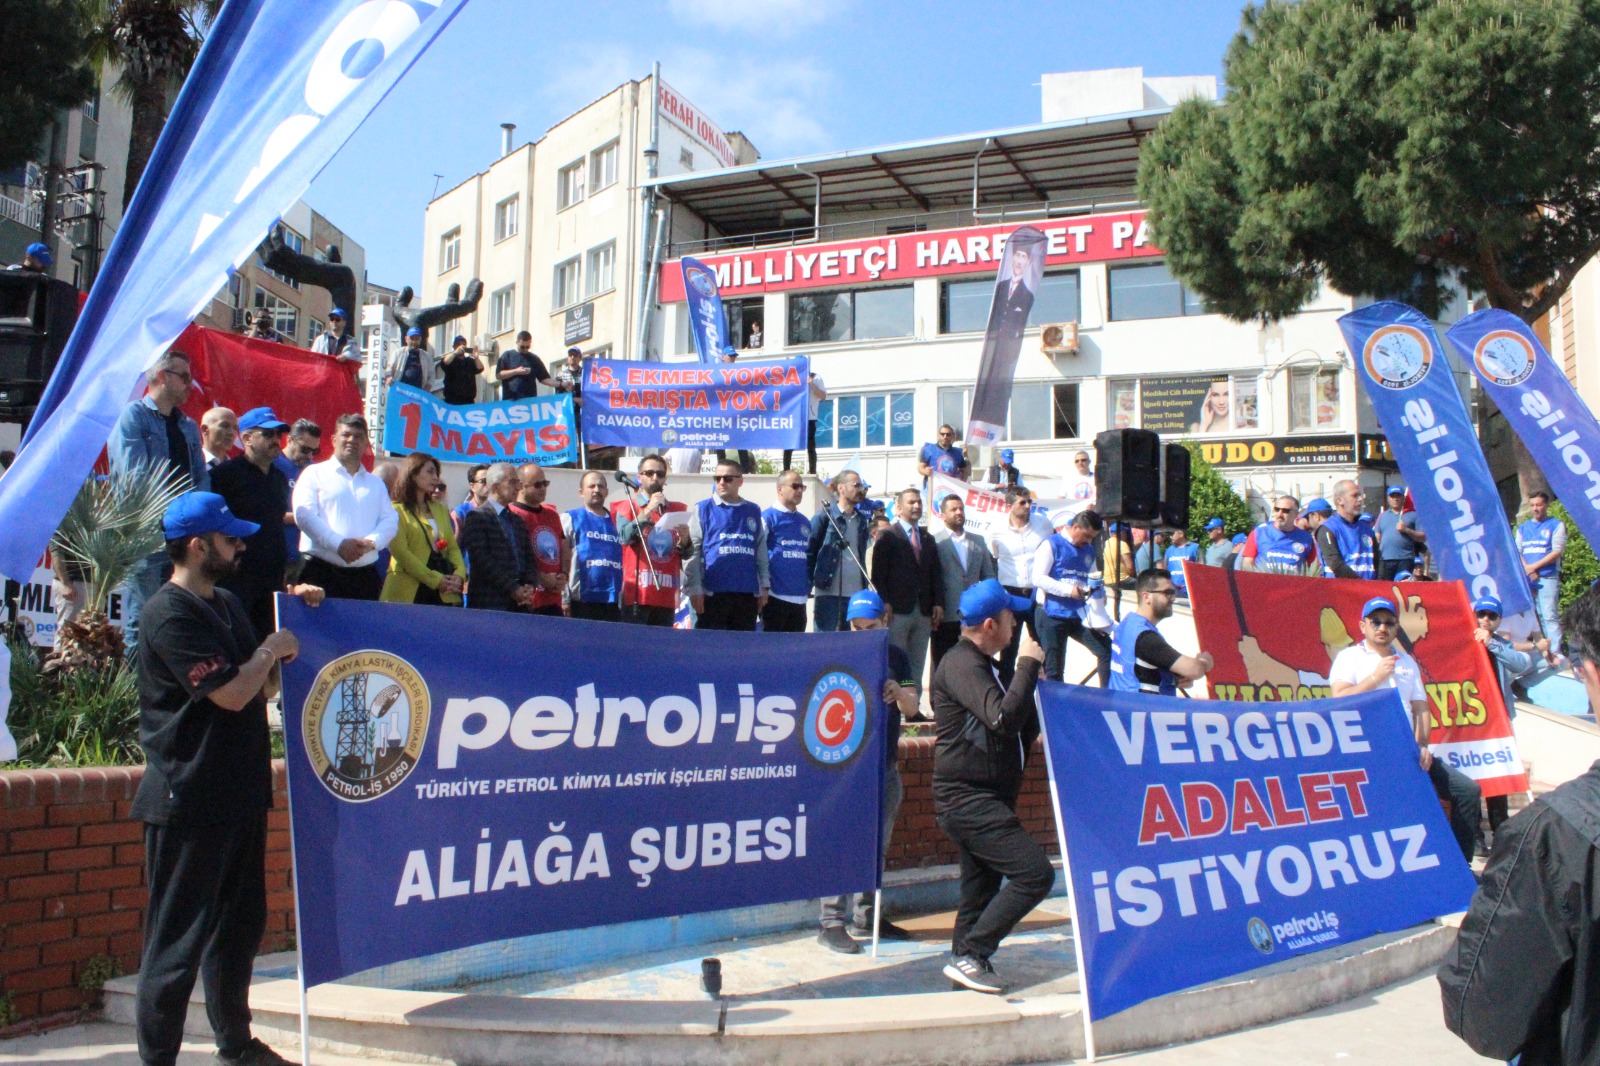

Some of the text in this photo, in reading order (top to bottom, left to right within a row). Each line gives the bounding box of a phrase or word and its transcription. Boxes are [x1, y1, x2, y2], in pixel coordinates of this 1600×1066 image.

[659, 86, 694, 130] FERAH
[707, 240, 897, 288] MİLLİYETÇİ
[916, 225, 1092, 268] HAREET
[627, 368, 715, 386] EKMEK
[718, 366, 801, 386] YOKSA
[432, 402, 563, 431] YAŞASIN
[609, 389, 710, 414] BARIŞTA
[716, 391, 767, 411] YOK
[1162, 399, 1193, 407] Epilasyon
[400, 402, 571, 457] 1 MAYIS
[597, 414, 793, 431] RAVAGO, EASTCHEM İŞÇİLERİ
[680, 433, 730, 443] petrol-iş
[586, 559, 623, 569] petrol-
[310, 679, 332, 718] PETROL
[331, 660, 361, 679] KİMYA
[363, 658, 395, 671] LASTİK
[1424, 680, 1487, 729] YIS
[437, 683, 796, 769] petrol-iş
[326, 760, 409, 797] PETROL-İŞ 1950
[415, 763, 797, 800] TÜRKİYE PETROL KİMYA LASTİK İŞÇİLERİ SENDİKASI
[1137, 768, 1369, 846] ADALET
[396, 803, 807, 907] ALİAĞA ŞUBESİ
[1271, 910, 1340, 944] petrol-iş
